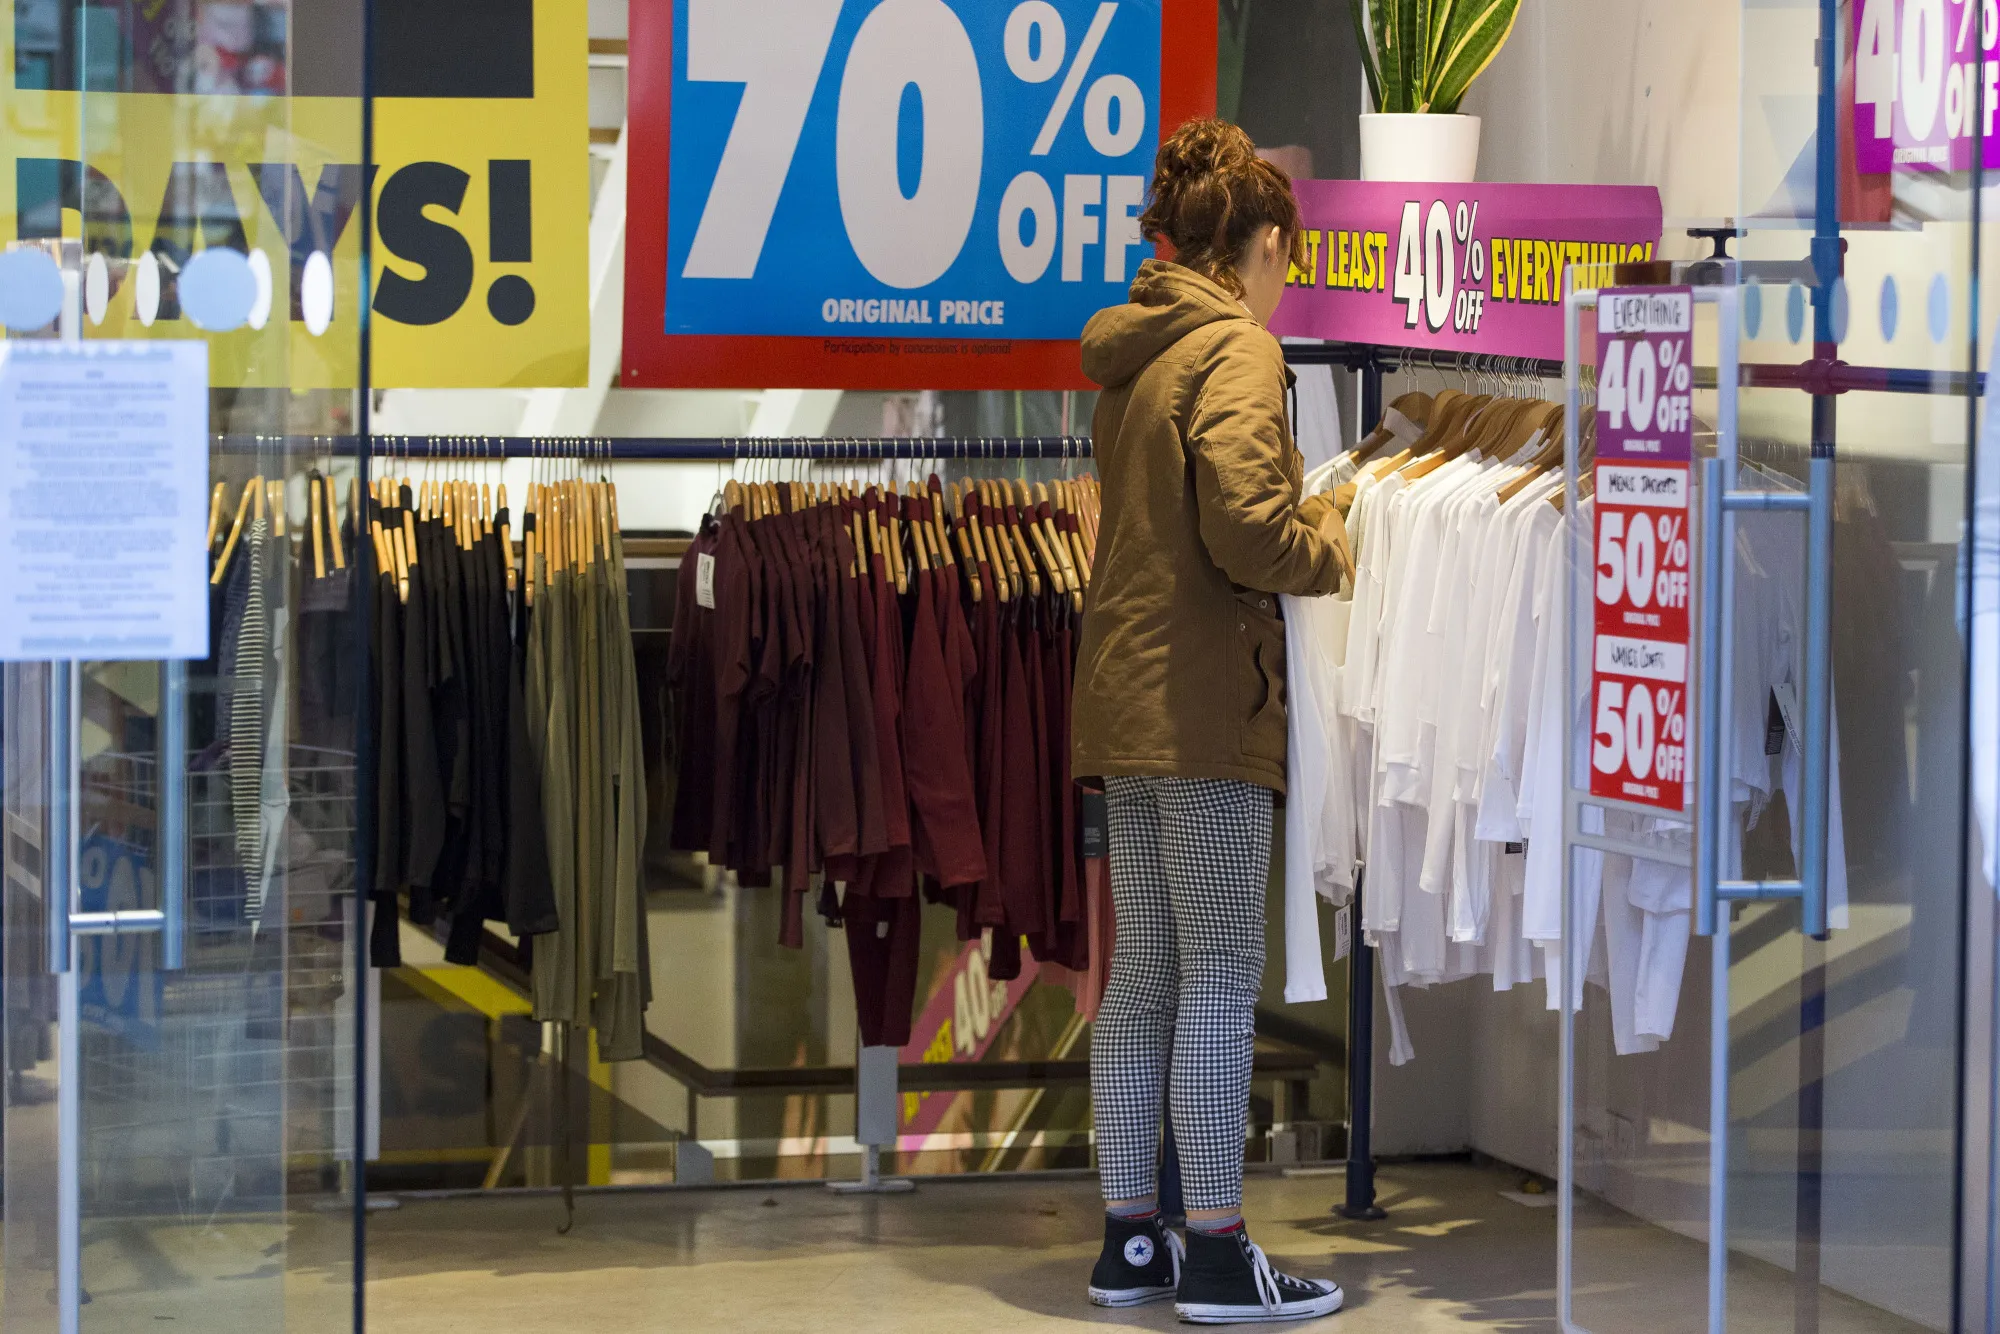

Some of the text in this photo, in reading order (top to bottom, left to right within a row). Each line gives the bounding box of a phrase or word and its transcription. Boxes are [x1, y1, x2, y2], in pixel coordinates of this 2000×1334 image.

[682, 0, 1145, 289] 70%
[998, 171, 1144, 283] OFF
[1326, 229, 1388, 292] LEAST
[1392, 199, 1485, 335] 40%
[822, 298, 1005, 325] ORIGINAL PRICE
[1453, 289, 1485, 334] OFF
[1613, 293, 1682, 330] EVERYTHING
[823, 339, 885, 356] Participation
[889, 339, 900, 357] by
[1597, 339, 1690, 433] 40%
[1656, 395, 1690, 433] OFF
[1596, 511, 1687, 608] 50%
[1655, 569, 1687, 608] OFF
[1593, 680, 1684, 780] 50%
[1655, 743, 1684, 782] OFF
